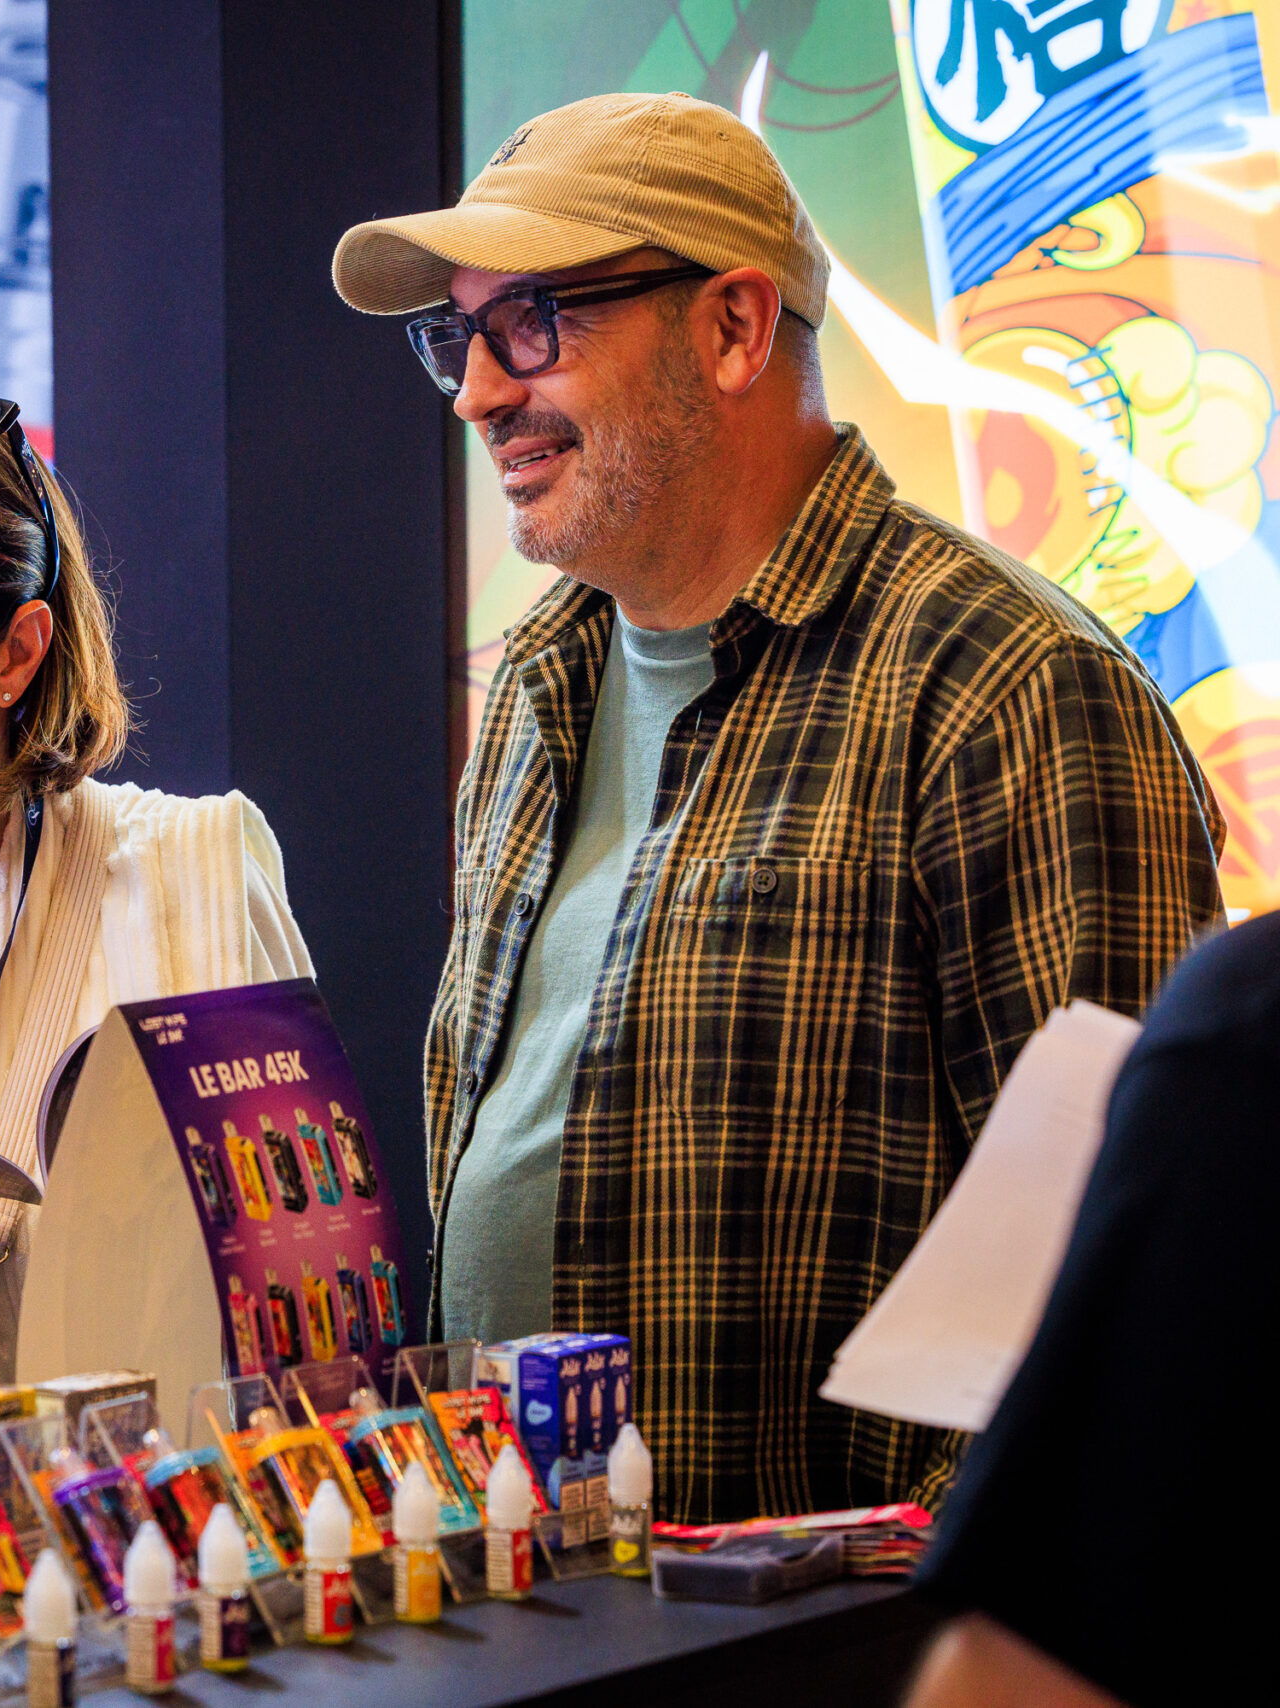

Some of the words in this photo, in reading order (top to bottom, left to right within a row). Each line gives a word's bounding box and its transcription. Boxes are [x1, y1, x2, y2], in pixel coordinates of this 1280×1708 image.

[188, 1064, 220, 1098] LE
[214, 1057, 266, 1094] BAR
[265, 1049, 310, 1085] 45K
